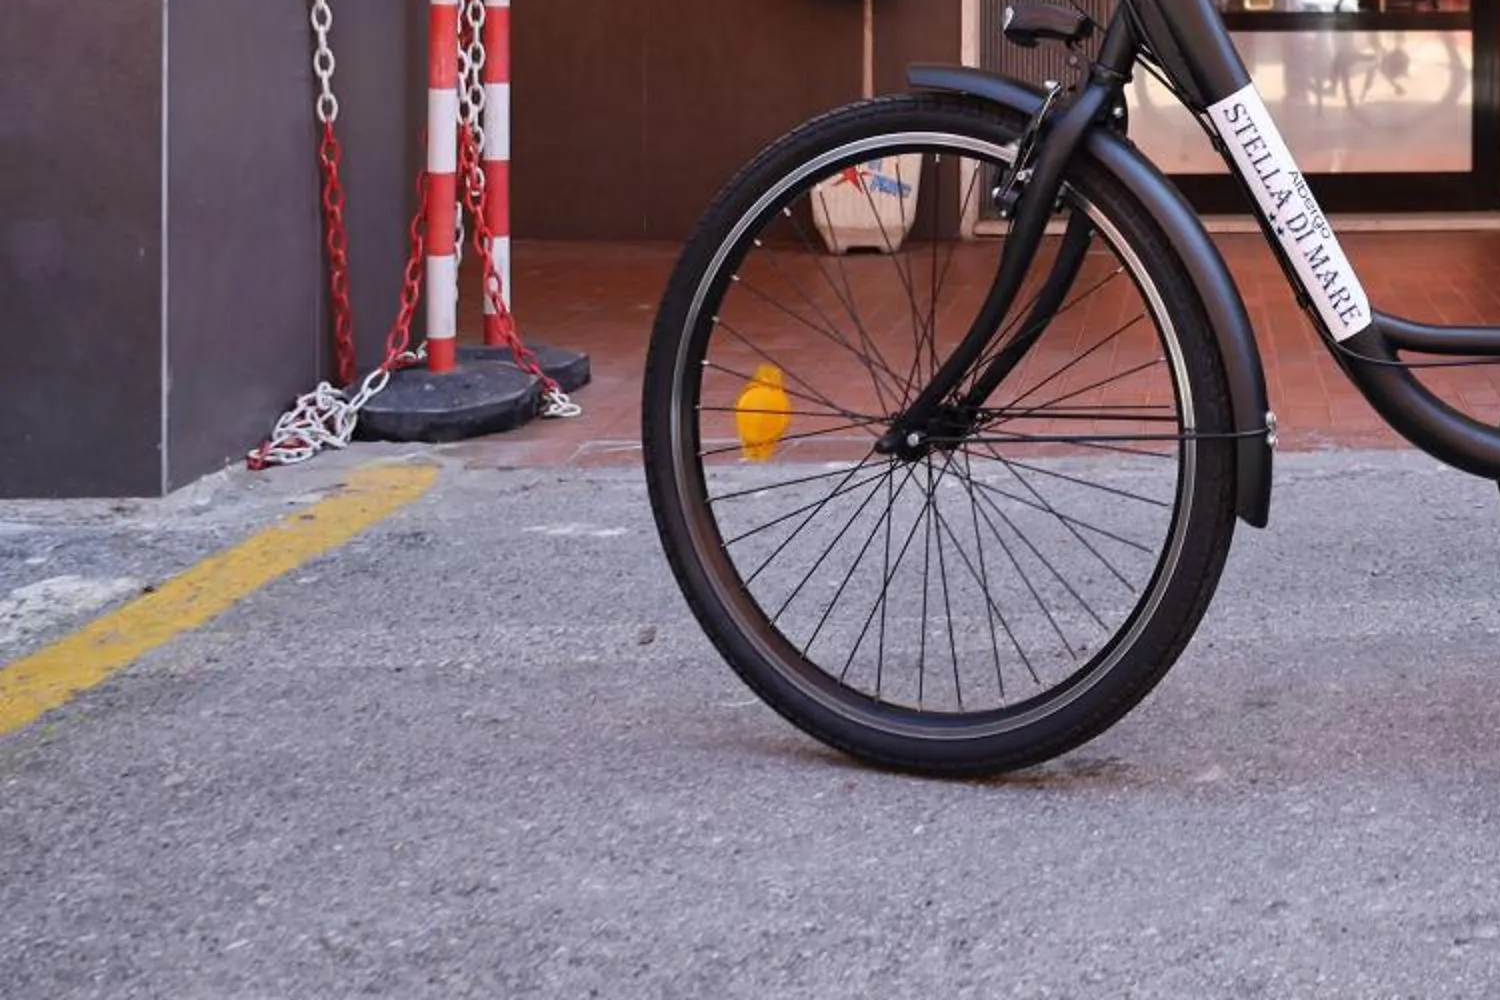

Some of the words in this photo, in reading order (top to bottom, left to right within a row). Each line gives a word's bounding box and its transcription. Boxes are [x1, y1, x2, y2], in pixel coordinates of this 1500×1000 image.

[1223, 102, 1294, 211] STELLA
[1285, 213, 1318, 244] DI
[1303, 243, 1363, 326] MARE
[1288, 170, 1331, 240] Albergo
